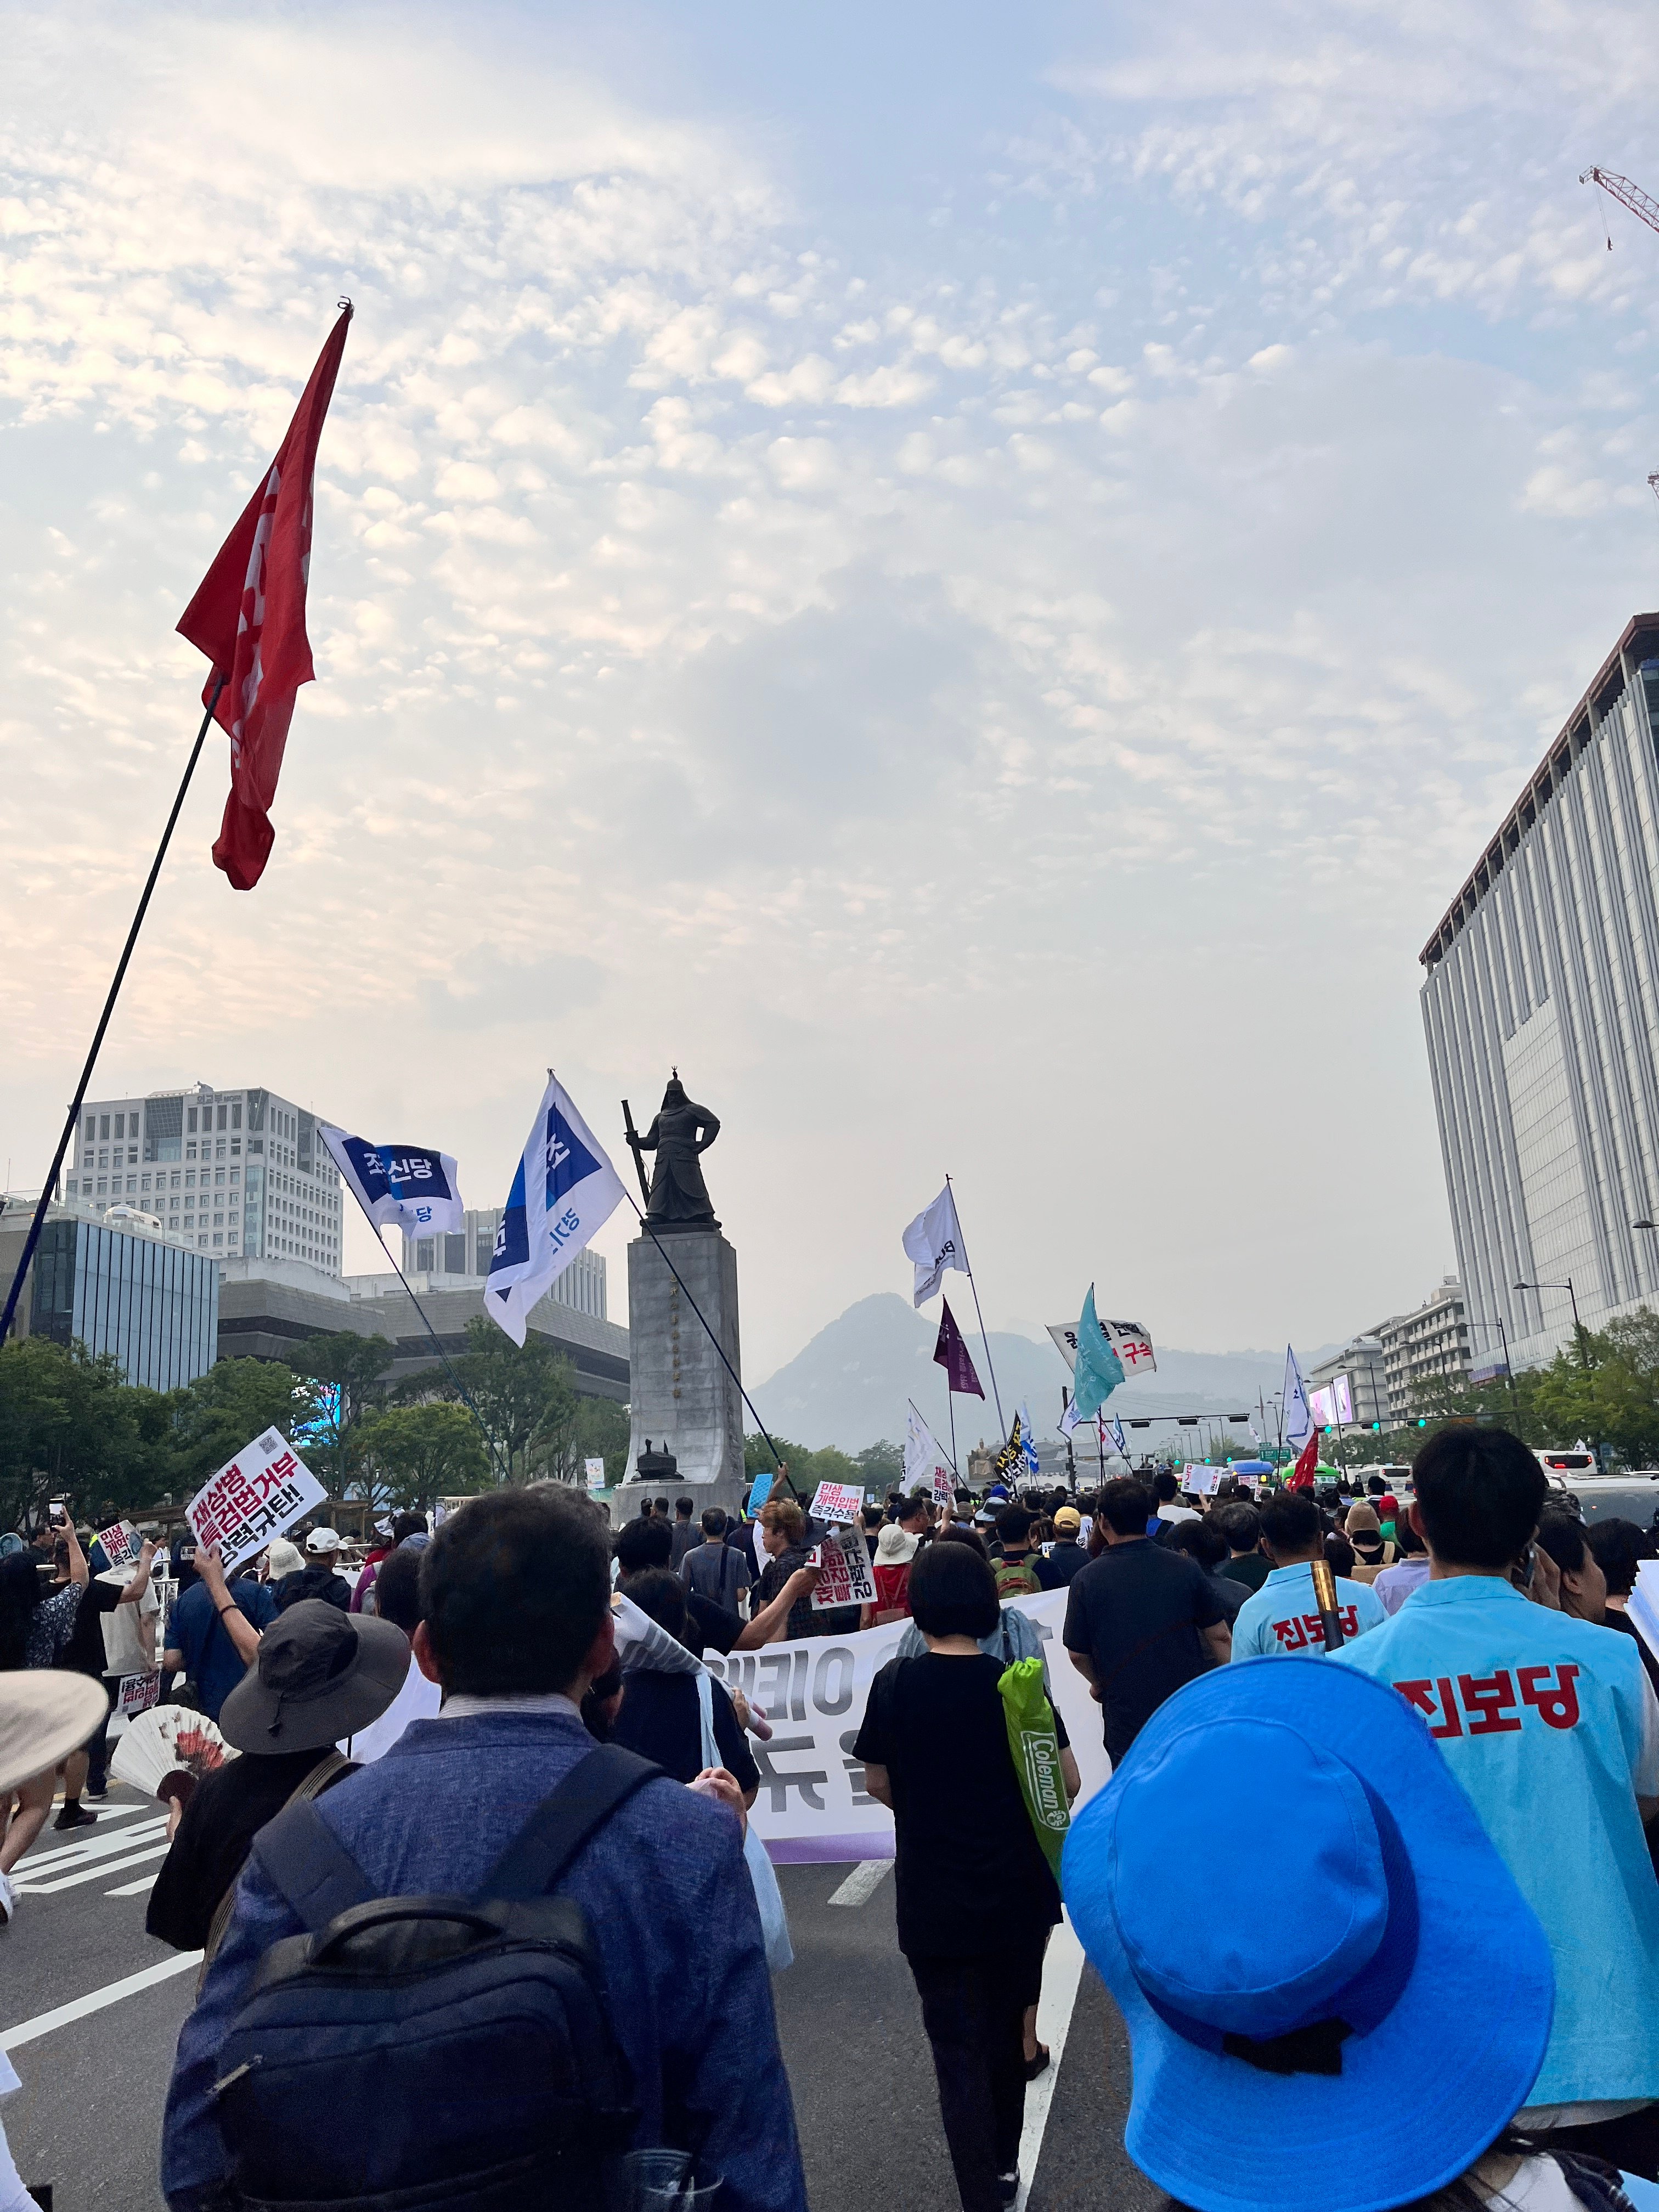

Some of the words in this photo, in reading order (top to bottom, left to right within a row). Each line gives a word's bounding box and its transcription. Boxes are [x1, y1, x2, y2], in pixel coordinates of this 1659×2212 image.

[197, 1094, 222, 1104] 외교부
[364, 1153, 432, 1183] 조신당
[193, 1464, 246, 1532] 채상병
[816, 1494, 859, 1510] 개혁입법
[820, 1483, 843, 1496] 민생
[100, 1524, 123, 1544] 민생
[105, 1533, 130, 1558] 개혁
[111, 1548, 133, 1566] 즉각
[1272, 1605, 1359, 1651] 진보당
[1392, 1664, 1579, 1739] 진보당
[1032, 1739, 1059, 1809] Coleman
